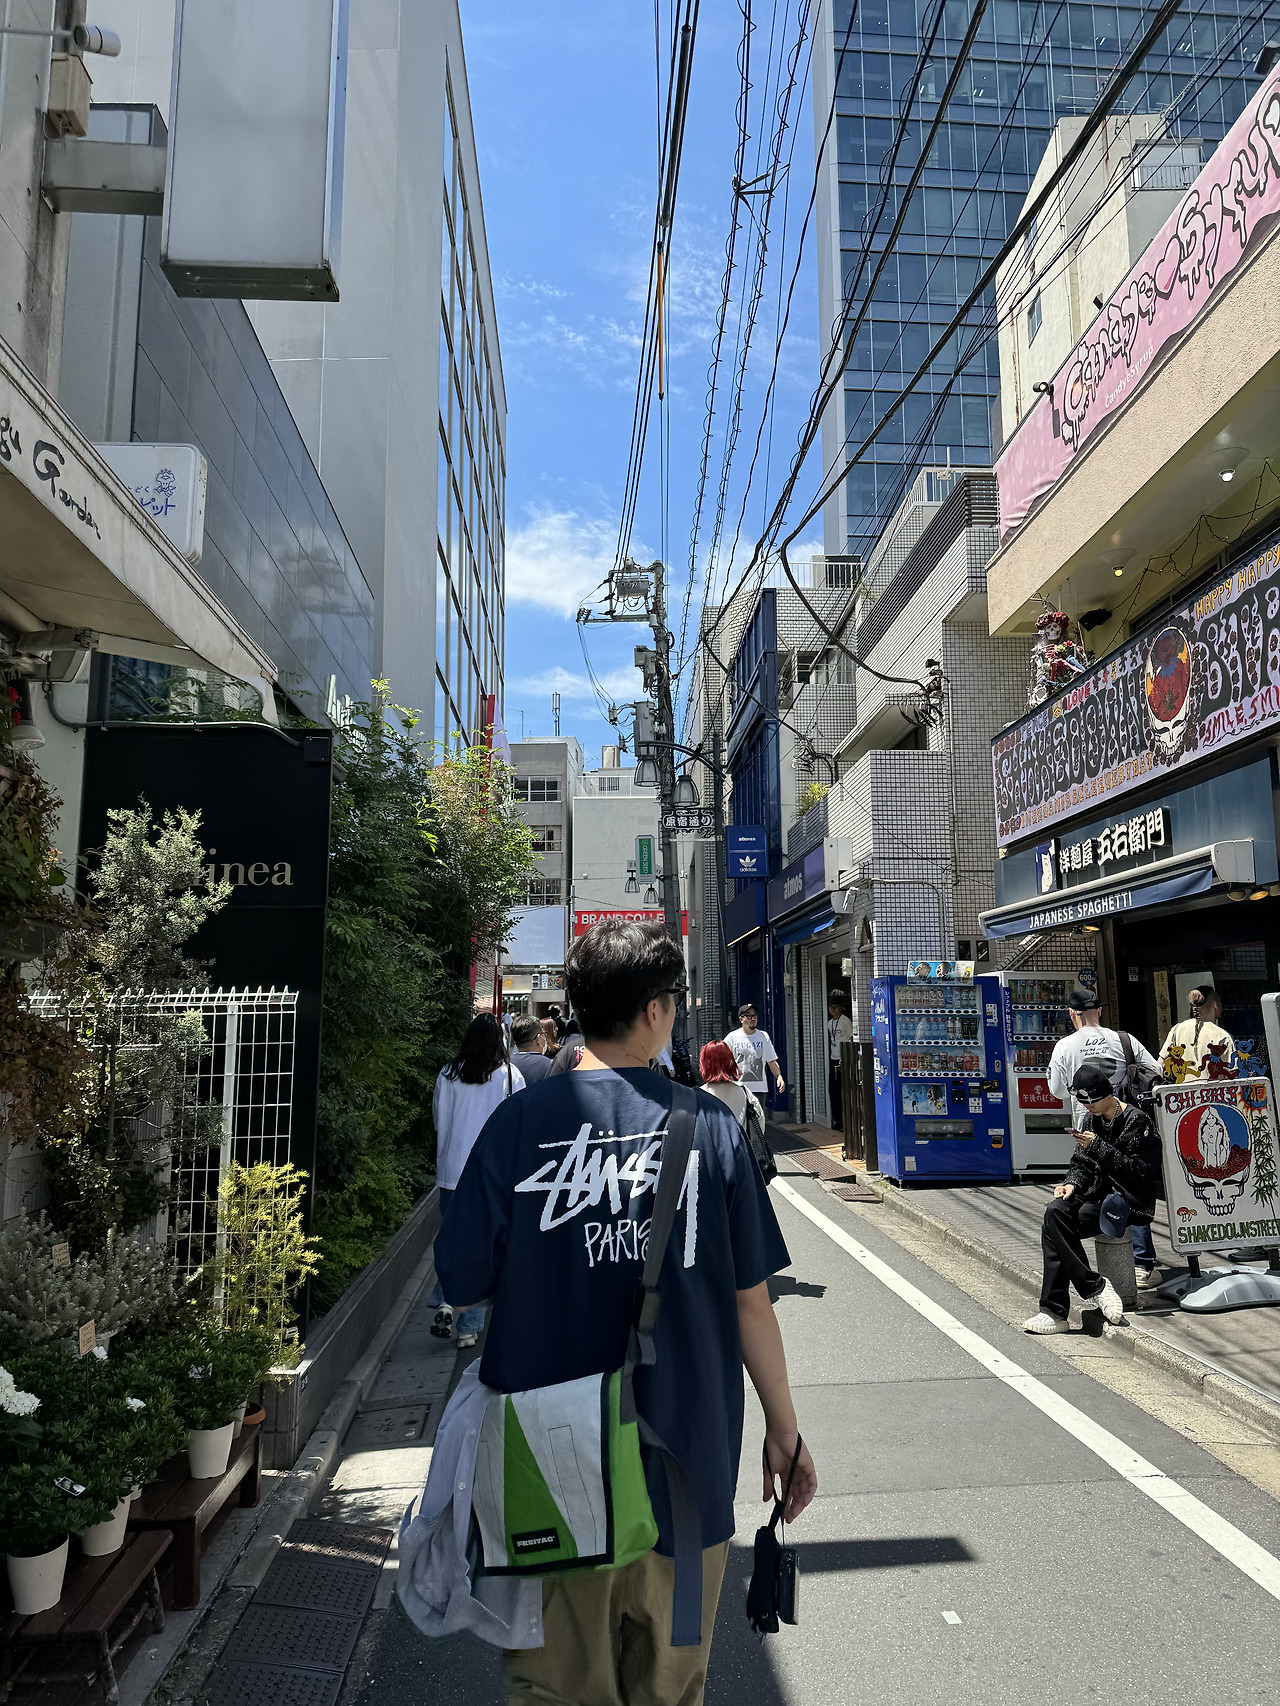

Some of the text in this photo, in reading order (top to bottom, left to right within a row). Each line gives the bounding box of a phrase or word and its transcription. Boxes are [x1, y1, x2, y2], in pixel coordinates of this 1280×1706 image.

[1196, 577, 1233, 622] HAPPY
[1067, 682, 1091, 711] LOVE
[665, 816, 711, 827] 原宿通り
[1029, 890, 1133, 929] JAPANESE SPAGHETTI
[516, 1536, 555, 1547] FREITAG
